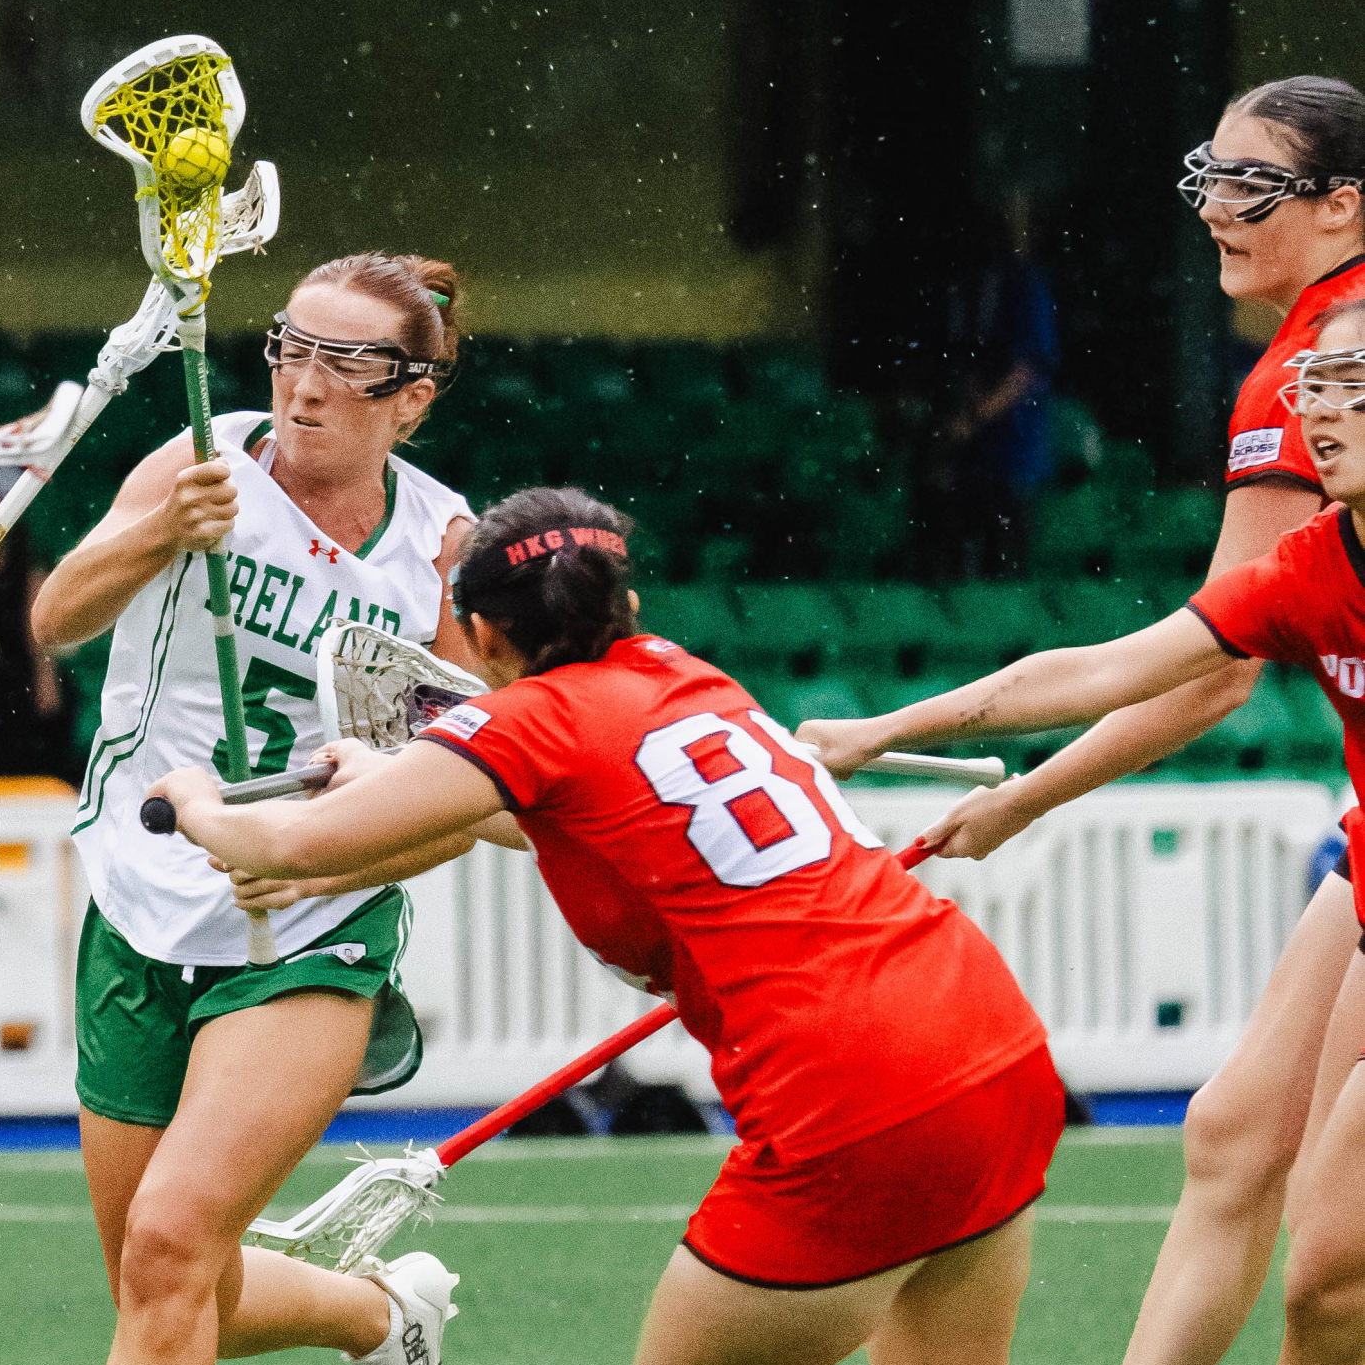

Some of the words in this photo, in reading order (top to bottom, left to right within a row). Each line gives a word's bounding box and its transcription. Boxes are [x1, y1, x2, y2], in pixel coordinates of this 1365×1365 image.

[505, 529, 565, 566] HKG
[204, 550, 402, 676] RELAND
[211, 655, 318, 782] 5
